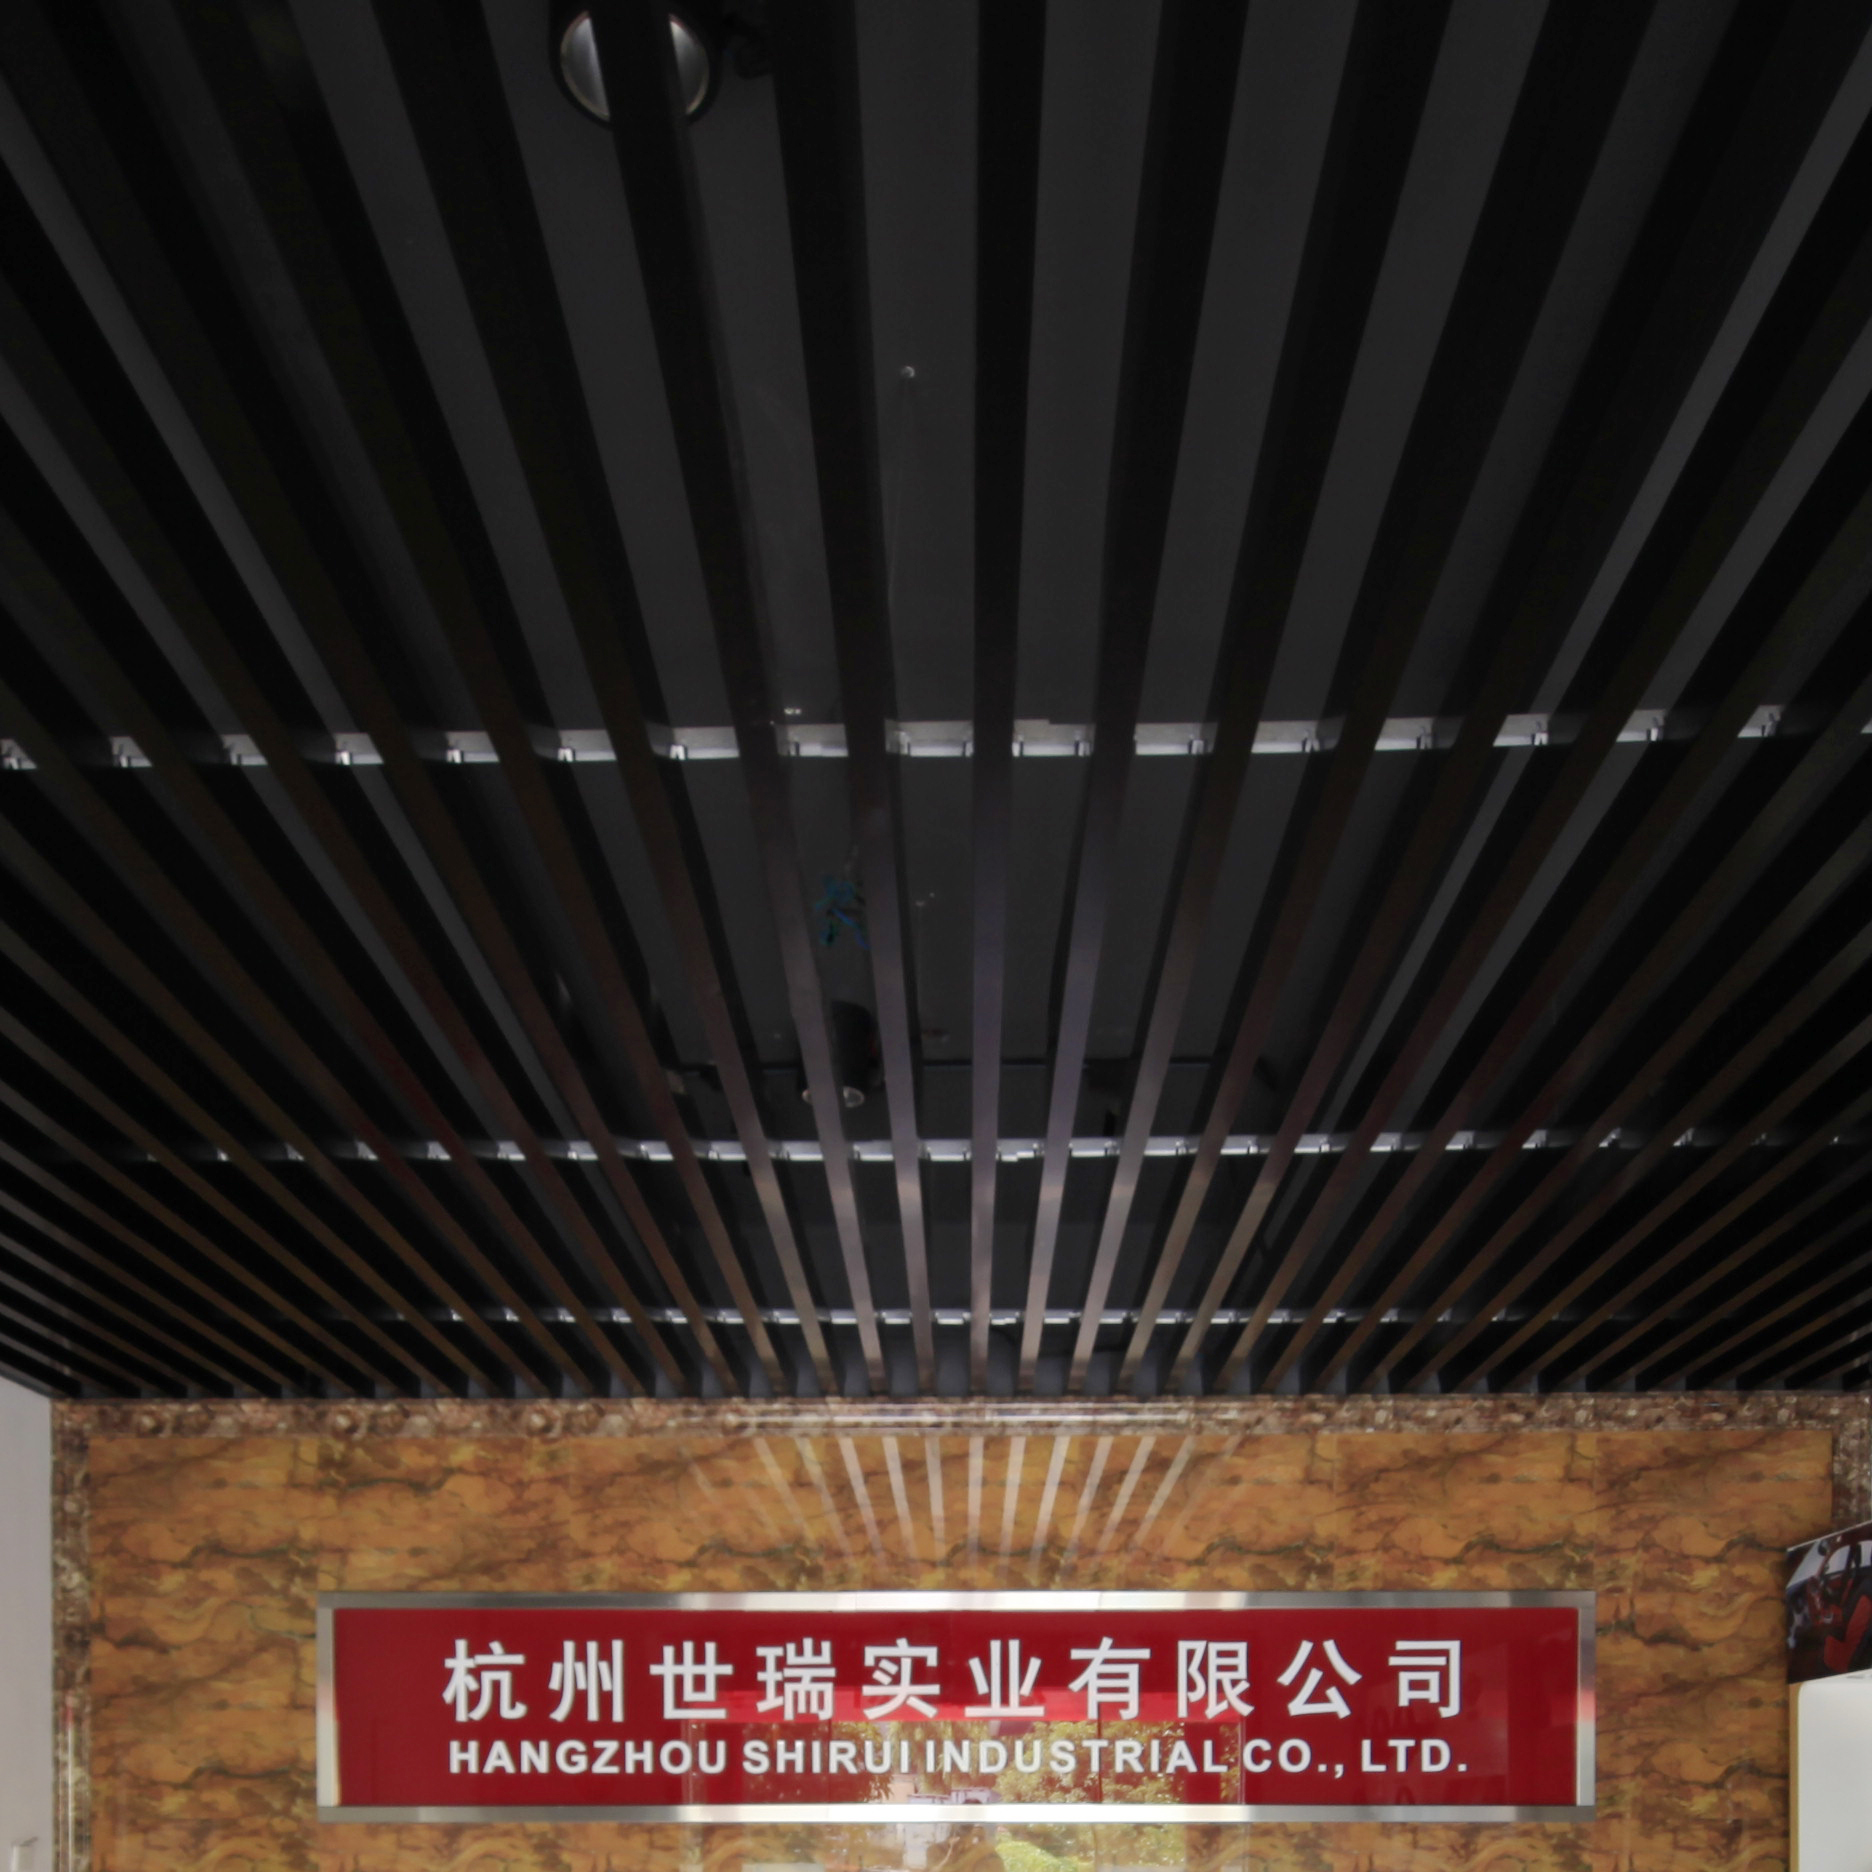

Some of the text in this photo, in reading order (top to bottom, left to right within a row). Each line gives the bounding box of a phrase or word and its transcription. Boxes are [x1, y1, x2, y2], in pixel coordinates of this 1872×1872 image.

[442, 1637, 1462, 1723] 杭州世瑞实业有限公司
[449, 1738, 1468, 1778] HANGZHOU SHIRUI INDUSTRIAL CO., LTD.
